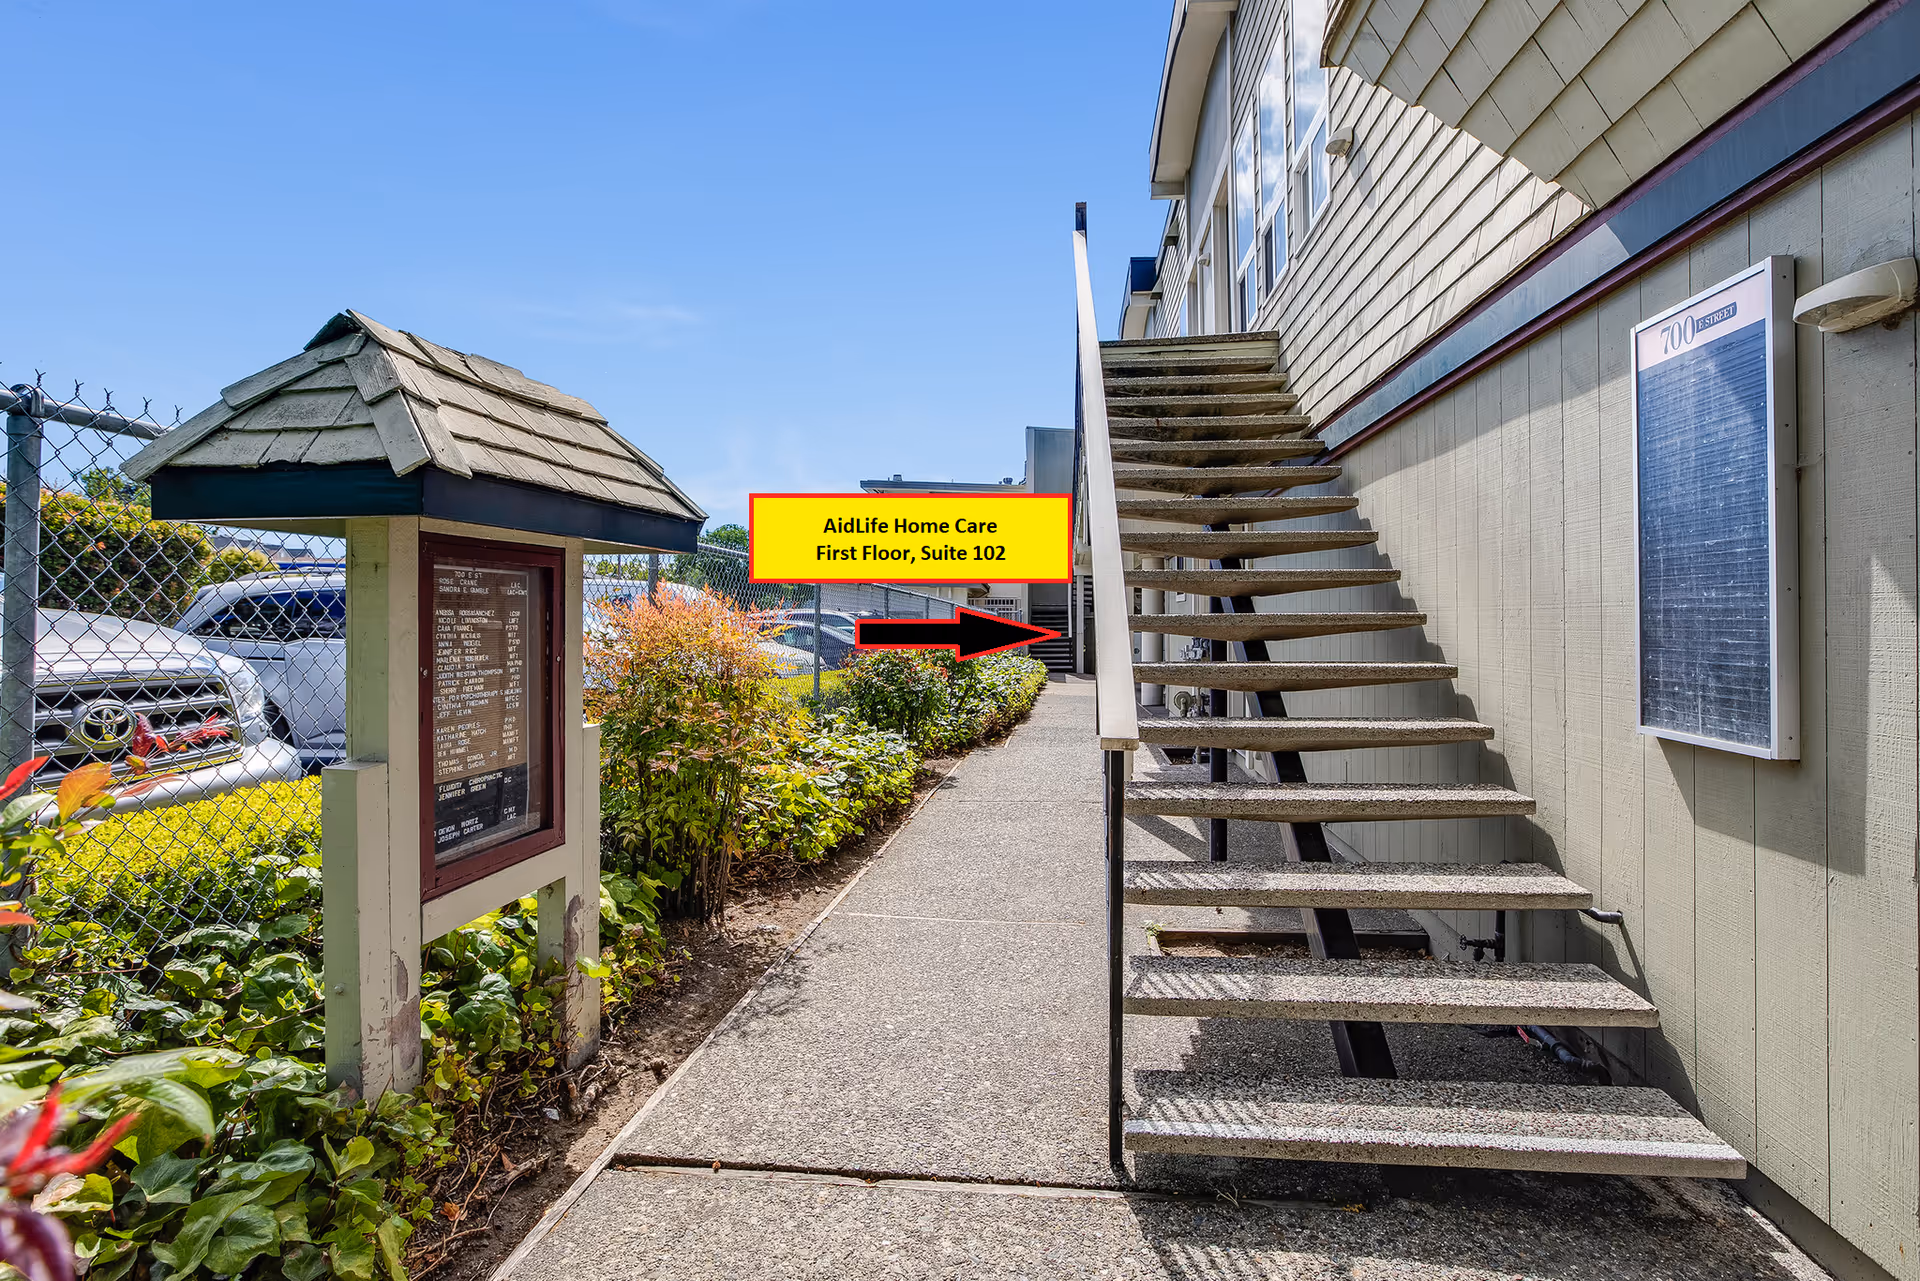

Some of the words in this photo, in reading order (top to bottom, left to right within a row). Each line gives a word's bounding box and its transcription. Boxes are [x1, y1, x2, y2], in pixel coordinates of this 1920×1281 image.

[1660, 315, 1695, 354] 700
[1699, 320, 1703, 329] E
[1705, 306, 1734, 326] STREET
[436, 726, 455, 734] KAREN
[438, 758, 459, 768] THOMAS
[439, 782, 462, 793] FLUIDITY
[439, 789, 465, 801] JENNIFER
[470, 783, 486, 792] GREEN
[438, 831, 460, 843] JOSEPH
[463, 824, 483, 835] CARTER
